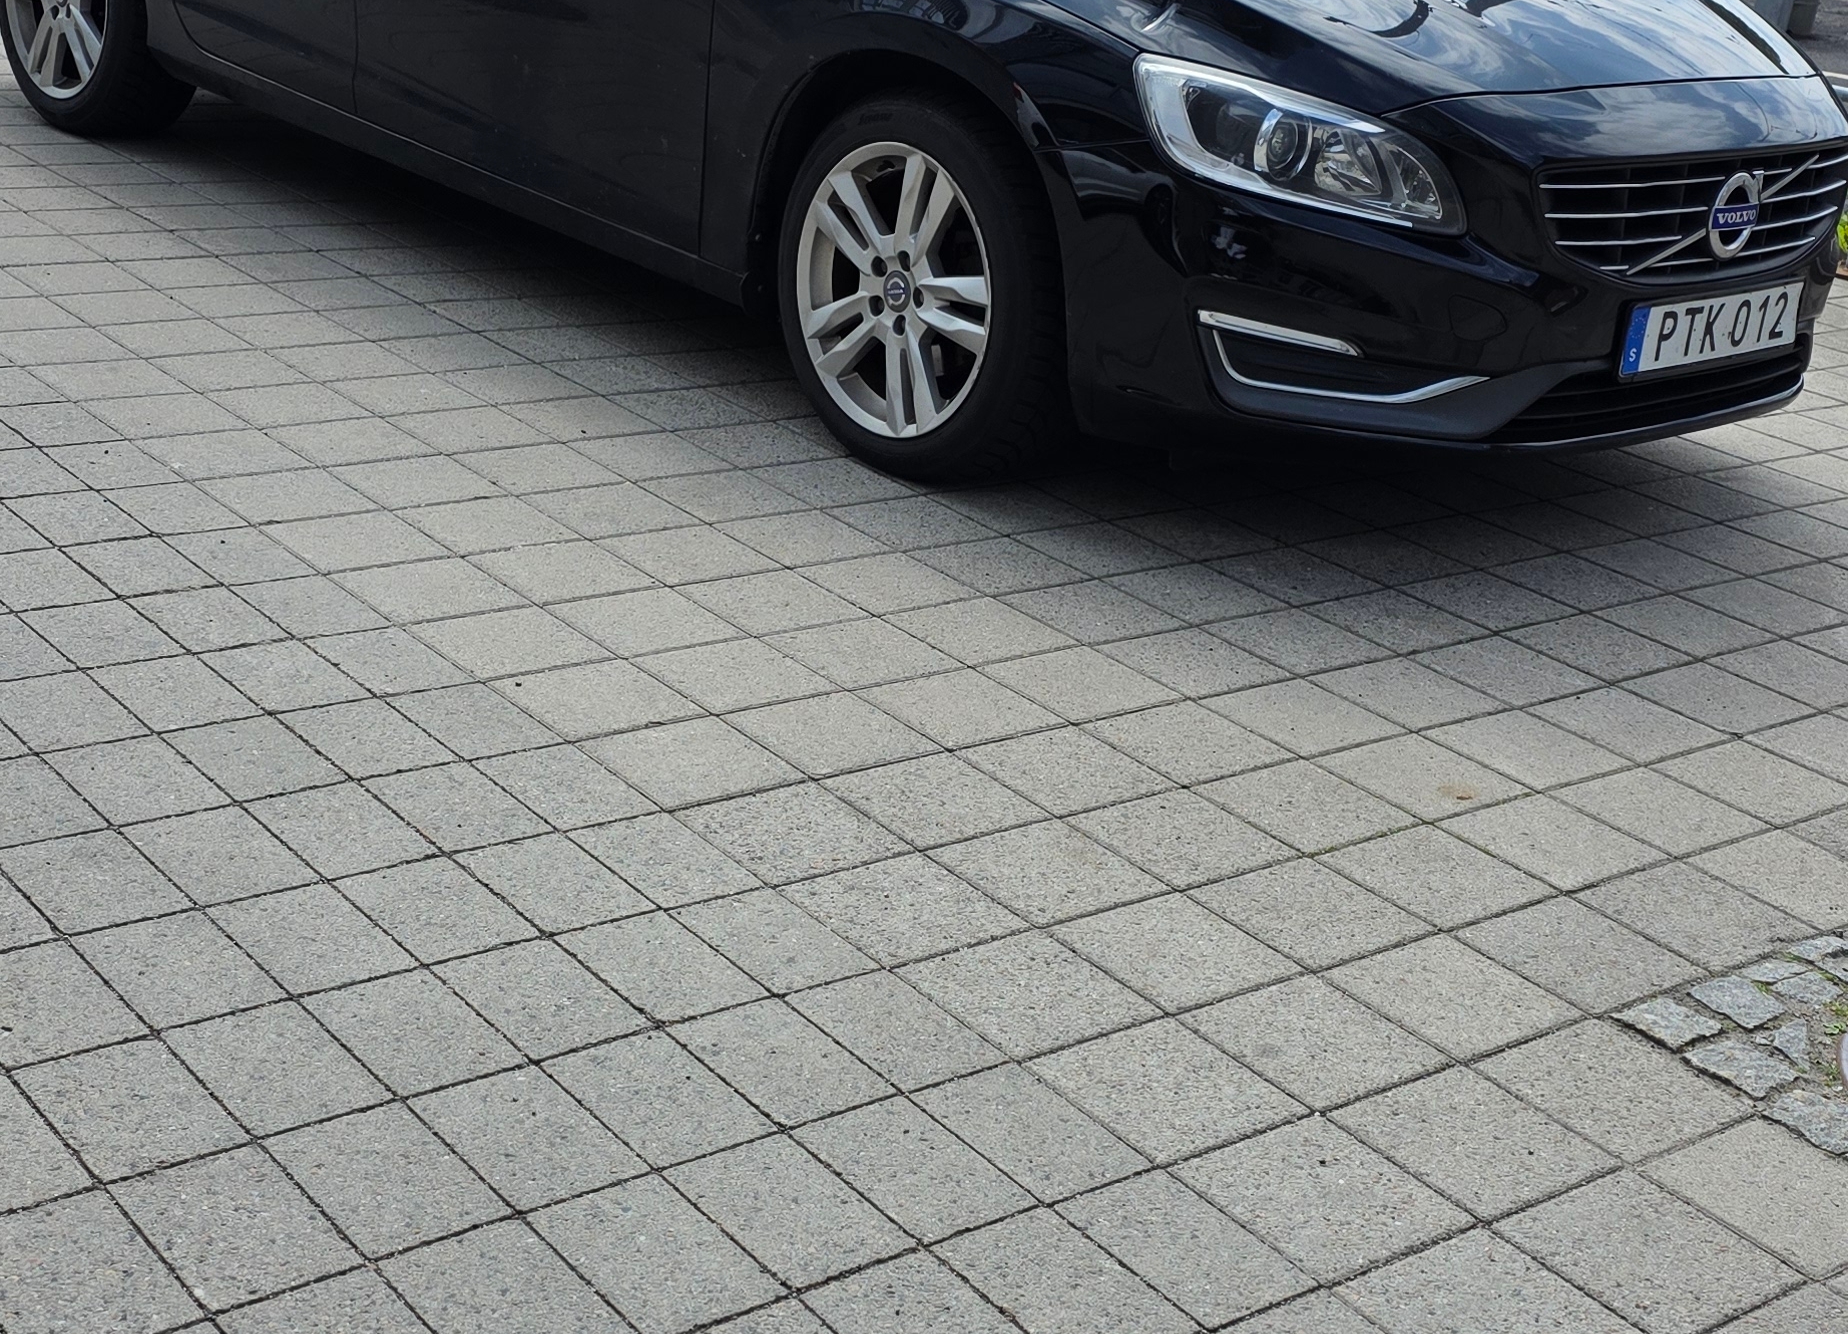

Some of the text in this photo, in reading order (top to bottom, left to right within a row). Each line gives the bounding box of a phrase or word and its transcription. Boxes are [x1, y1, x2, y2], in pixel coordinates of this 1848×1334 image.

[1716, 209, 1756, 224] VOLVO
[1654, 291, 1789, 362] PTK 012
[1628, 348, 1637, 362] S
